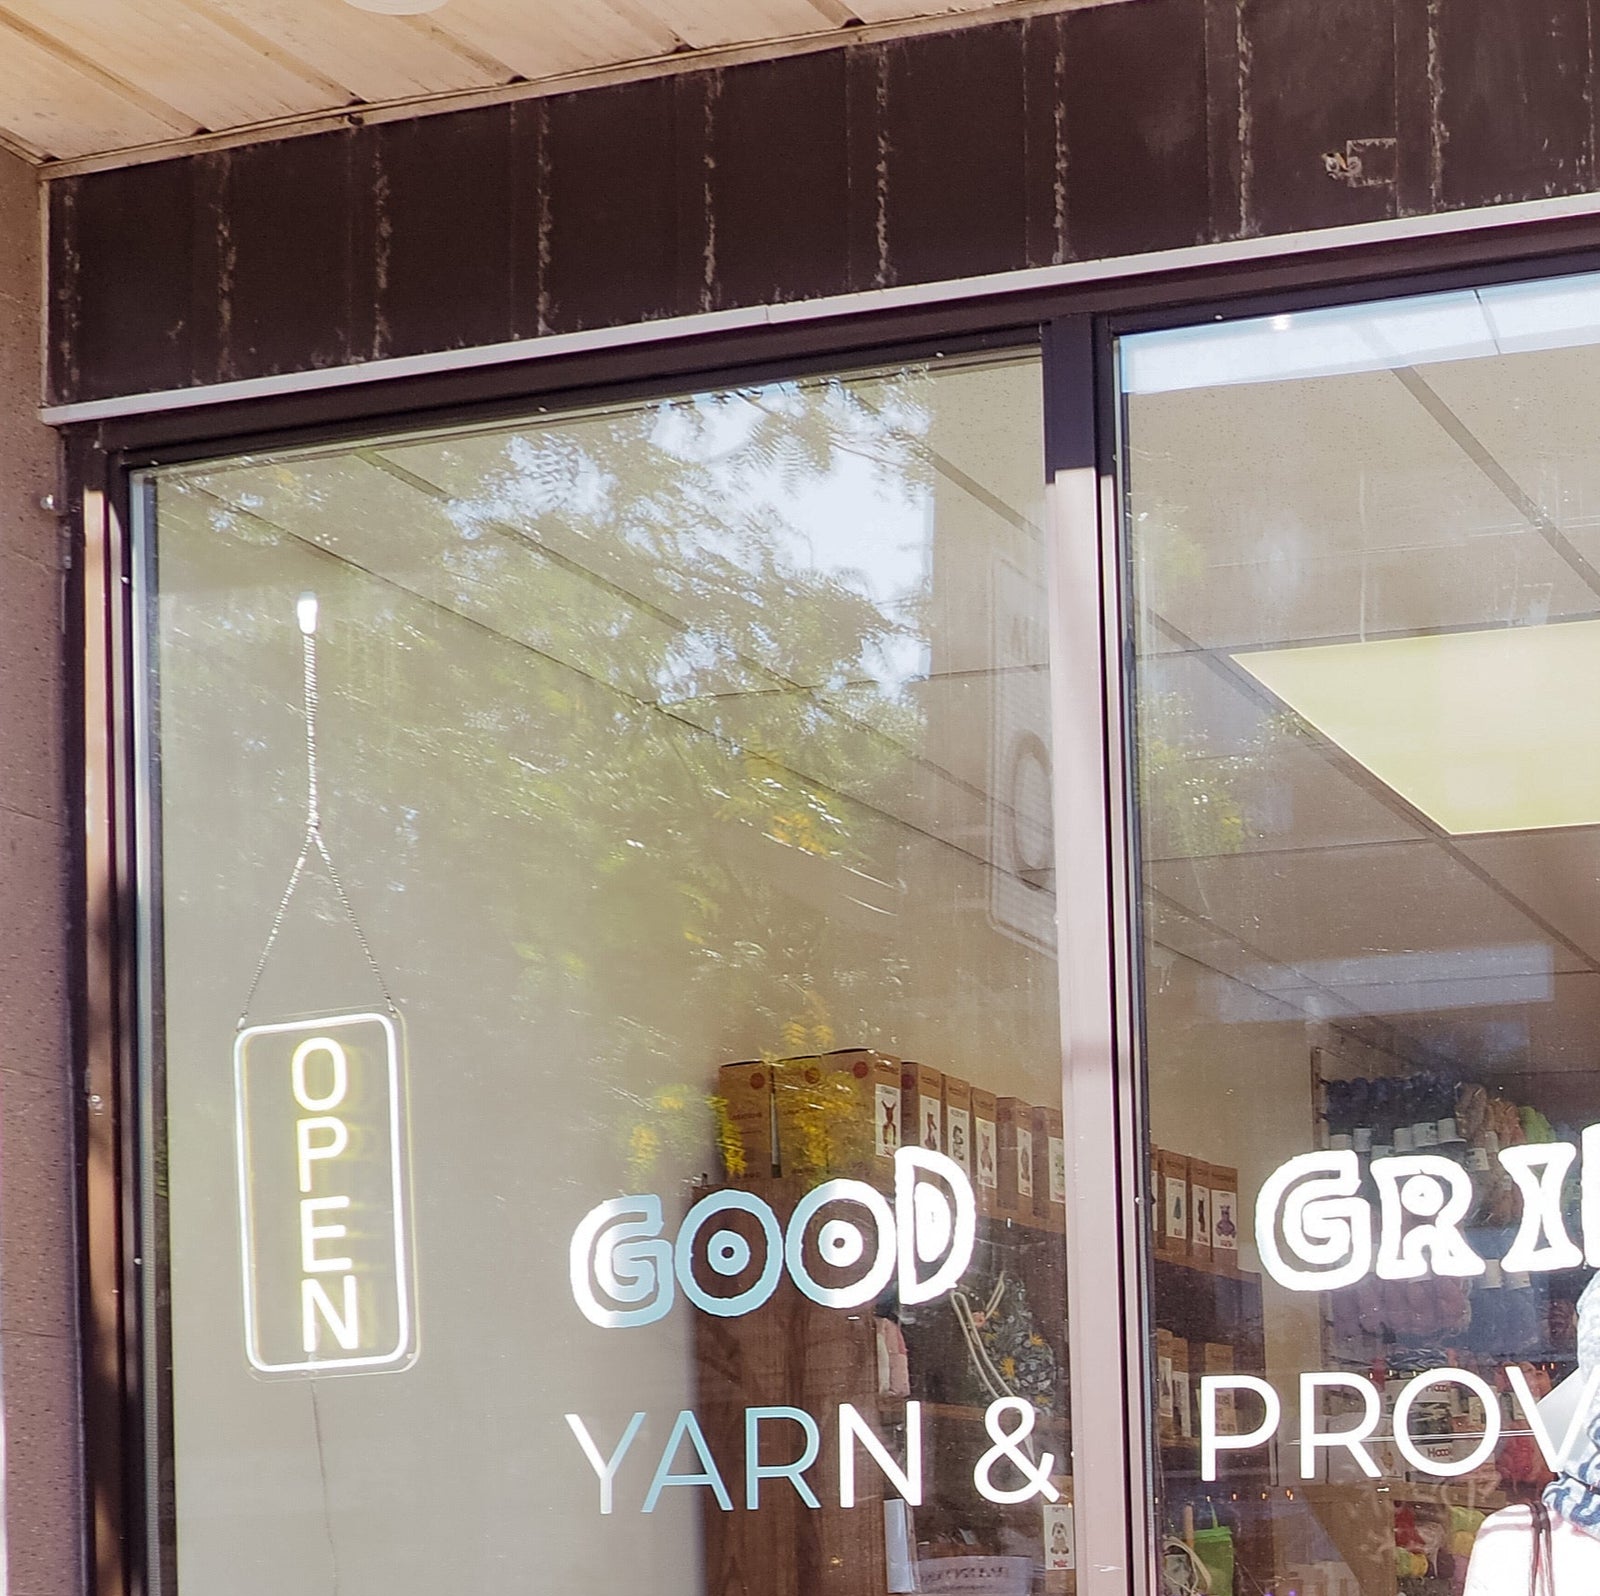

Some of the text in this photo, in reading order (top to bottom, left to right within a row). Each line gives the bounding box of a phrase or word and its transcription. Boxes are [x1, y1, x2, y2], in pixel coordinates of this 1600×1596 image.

[291, 1037, 359, 1353] OPEN
[569, 1145, 976, 1328] GOOD
[565, 1400, 923, 1514] YARN
[974, 1396, 1060, 1505] &
